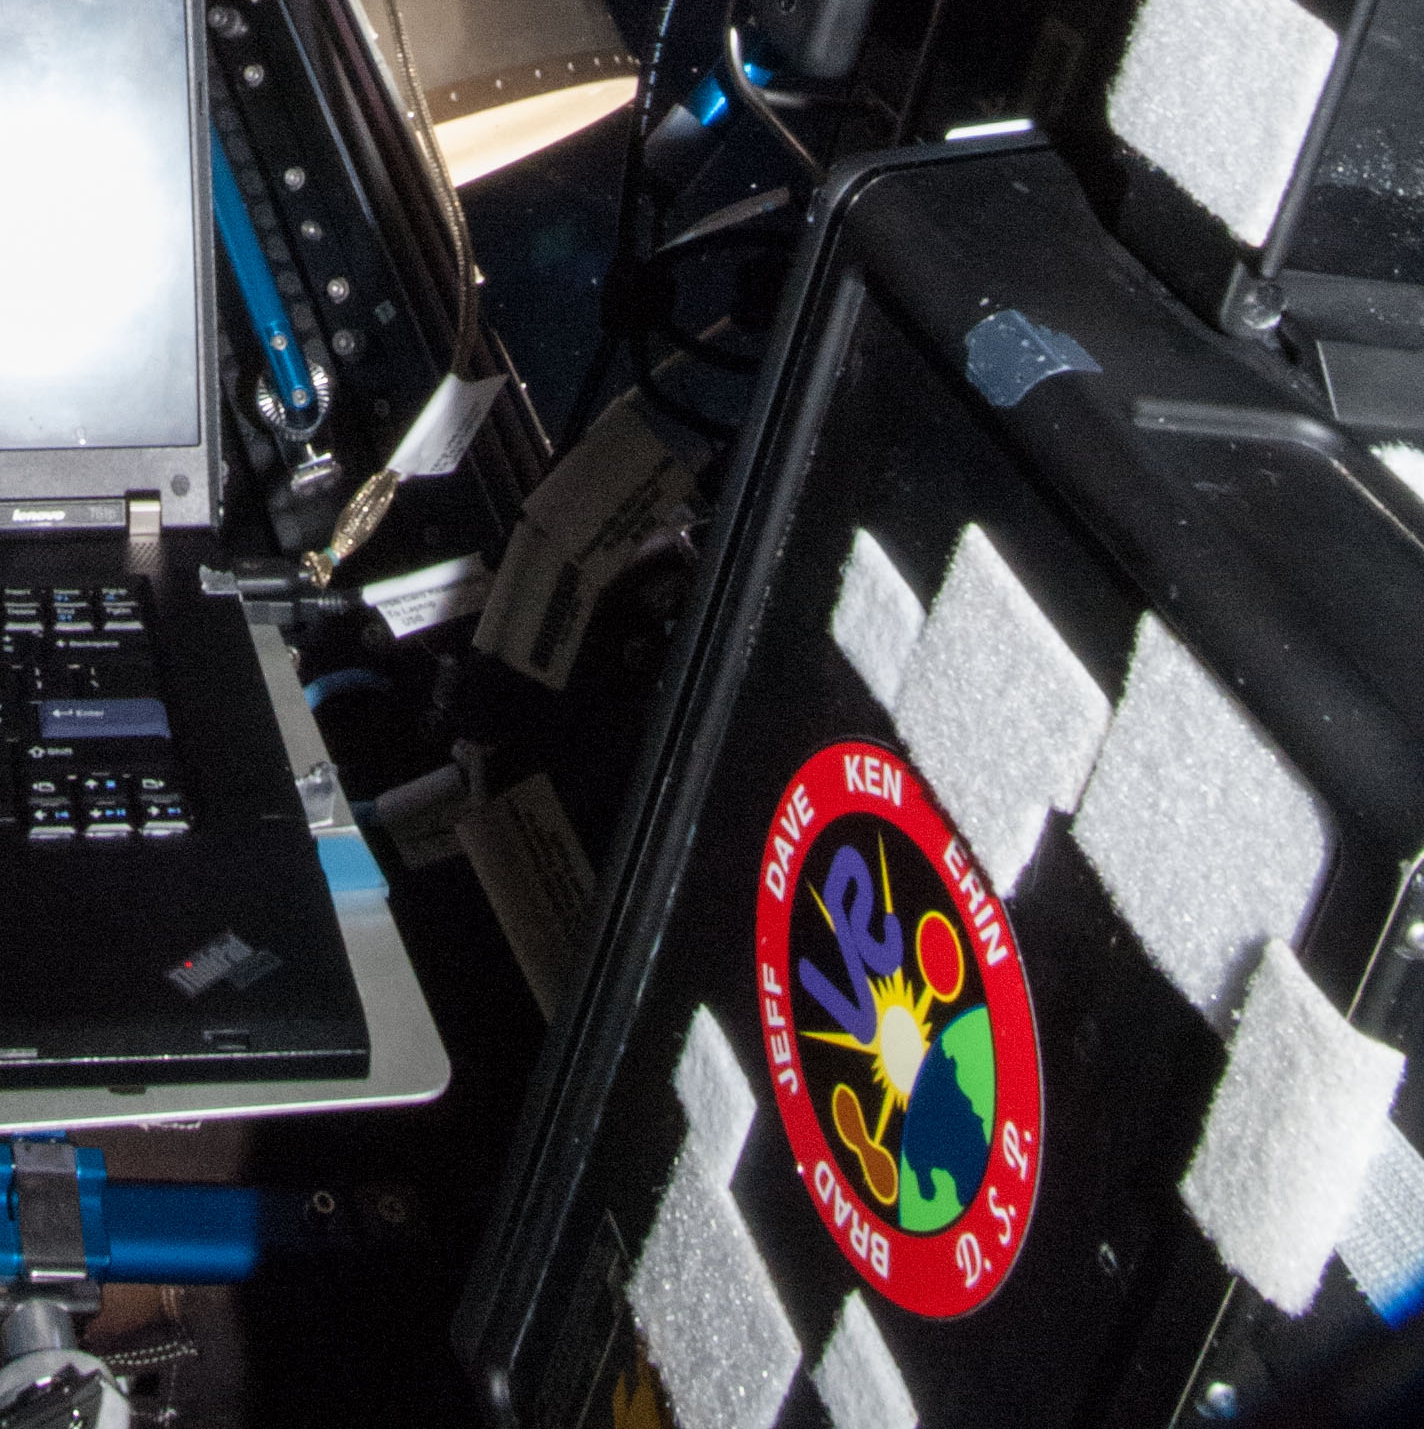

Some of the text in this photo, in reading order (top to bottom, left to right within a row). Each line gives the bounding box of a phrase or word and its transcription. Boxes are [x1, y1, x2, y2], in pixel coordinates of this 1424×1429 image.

[12, 508, 66, 522] lenovo
[763, 785, 817, 899] DAVE
[843, 753, 1009, 968] KEN ERIN
[760, 962, 801, 1097] JEFF
[813, 1159, 891, 1280] BRAD
[955, 1126, 1032, 1289] D. S. P.
